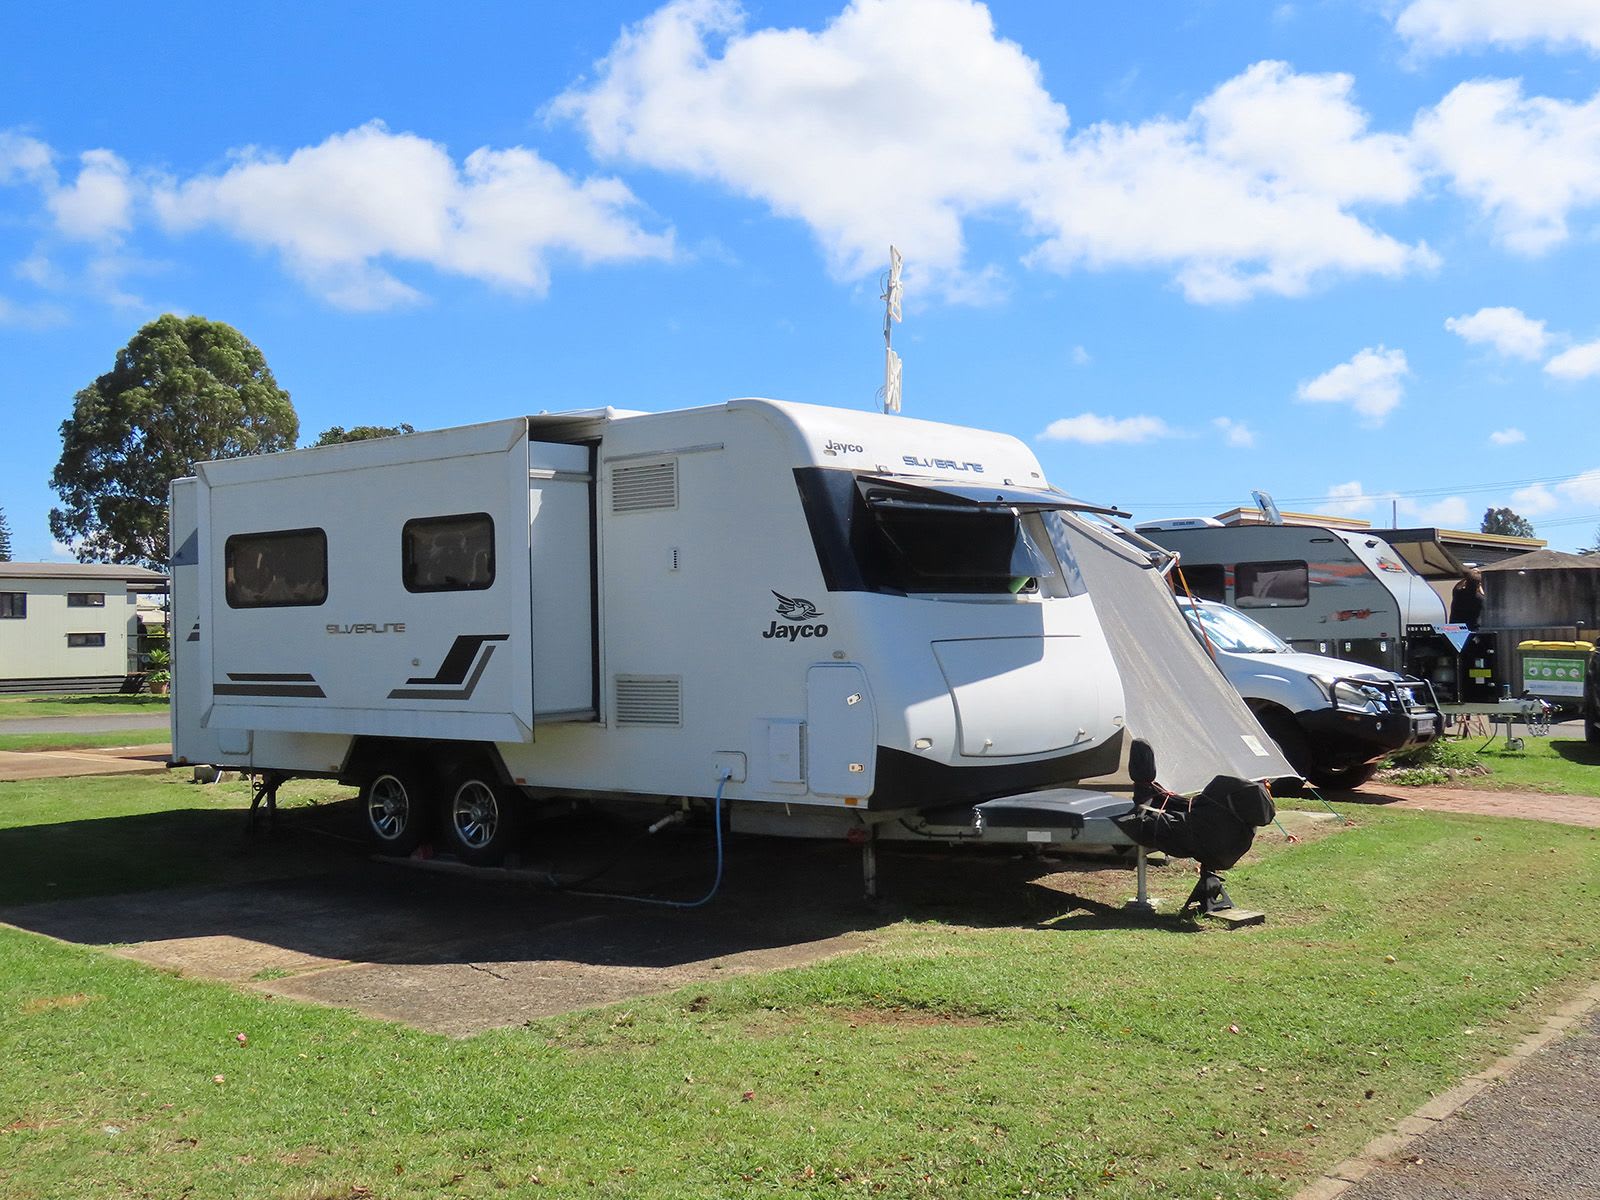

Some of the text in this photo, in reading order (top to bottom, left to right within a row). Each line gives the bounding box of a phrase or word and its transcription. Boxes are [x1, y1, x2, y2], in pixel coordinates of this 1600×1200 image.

[825, 439, 864, 454] Jayco
[902, 455, 984, 473] SILVERLINE
[326, 622, 406, 634] SILVERLINE
[762, 620, 829, 642] Jayco
